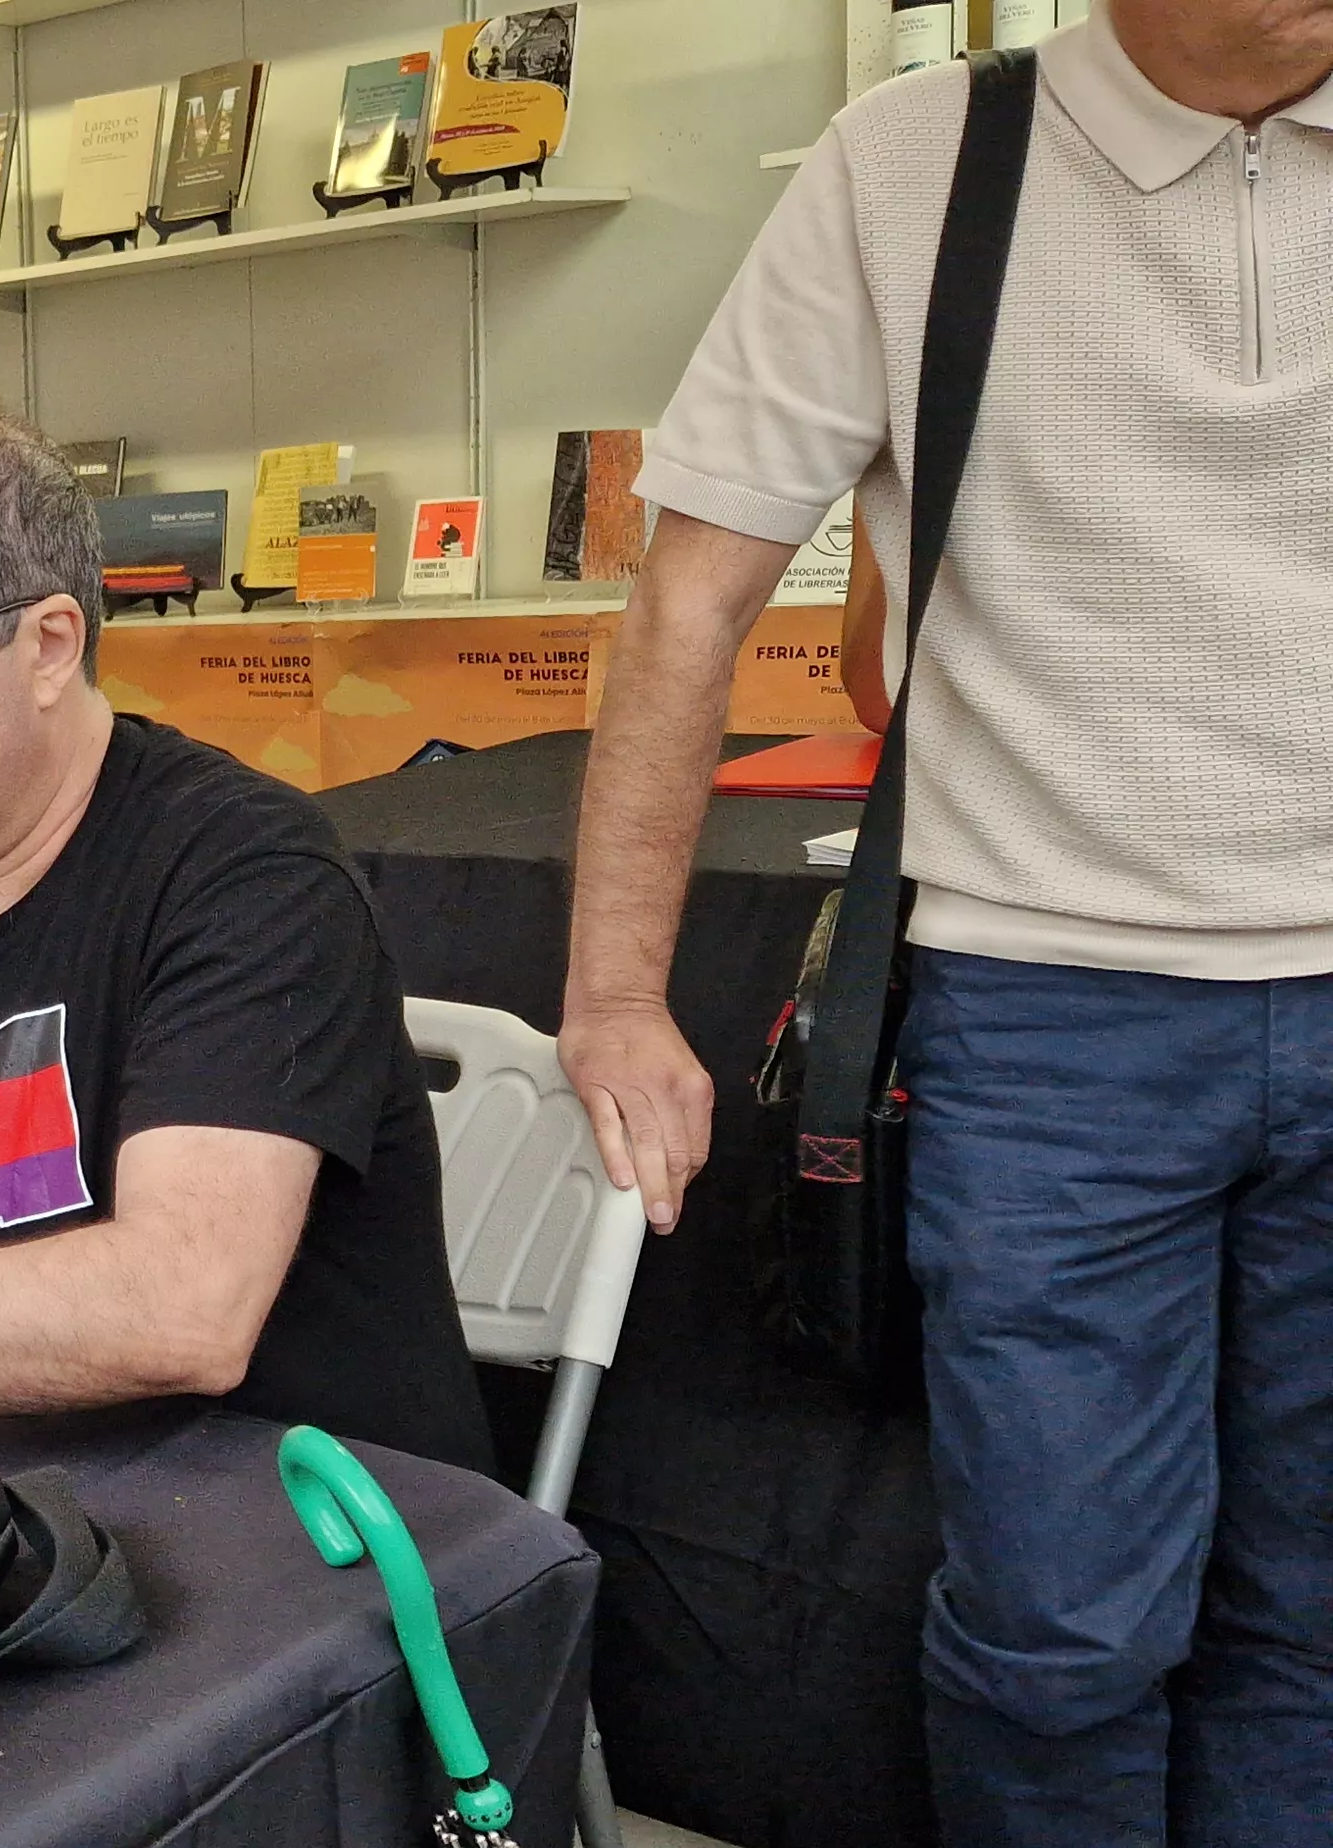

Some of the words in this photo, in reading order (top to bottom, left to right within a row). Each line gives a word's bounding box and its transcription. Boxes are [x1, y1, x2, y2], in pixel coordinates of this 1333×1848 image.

[84, 119, 120, 134] Largo
[124, 116, 139, 126] es
[82, 132, 93, 147] el
[97, 130, 139, 144] tiempo
[151, 513, 176, 523] Viajes
[785, 566, 845, 577] ASOCIACIÓN
[783, 579, 796, 588] DE
[798, 579, 849, 588] LIBRERIAS
[458, 652, 502, 664] FERIA
[508, 651, 537, 664] DEL
[544, 651, 589, 664] LIBRO
[756, 646, 808, 660] FERIA
[200, 656, 237, 668] FERIA
[243, 656, 267, 668] DEL
[271, 655, 311, 668] LIBRO
[504, 668, 522, 681] DE
[808, 664, 831, 678] DE
[238, 672, 254, 684] DE
[260, 672, 311, 684] HUESCA
[248, 689, 269, 698] Plaza
[270, 689, 292, 699] López
[515, 687, 540, 696] Plaza
[542, 687, 569, 697] López
